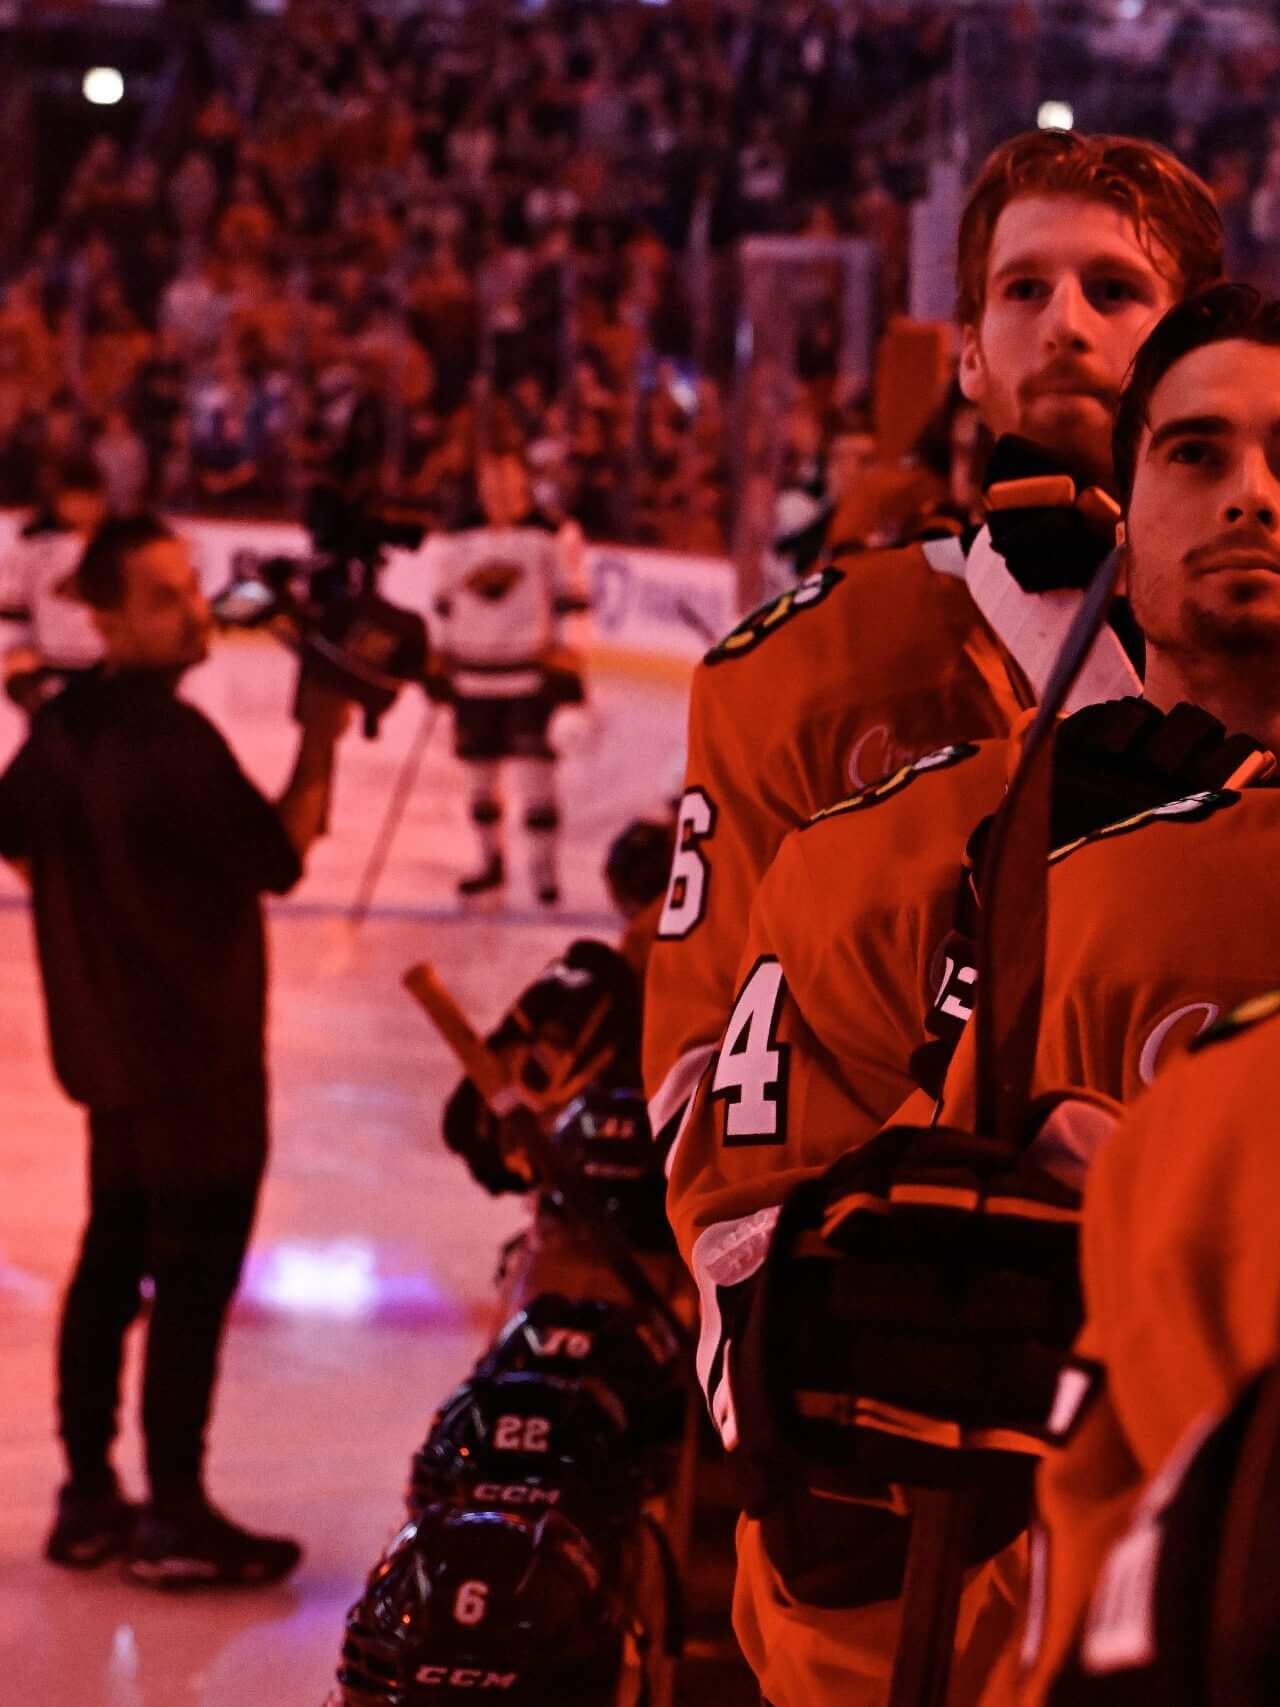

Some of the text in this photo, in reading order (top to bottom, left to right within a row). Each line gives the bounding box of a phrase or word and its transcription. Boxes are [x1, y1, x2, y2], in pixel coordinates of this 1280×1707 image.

[657, 788, 714, 938] 6
[711, 958, 784, 1141] 4
[495, 1415, 551, 1452] 22
[473, 1484, 561, 1504] CCM
[455, 1580, 489, 1625] 6
[415, 1665, 517, 1689] CCM
